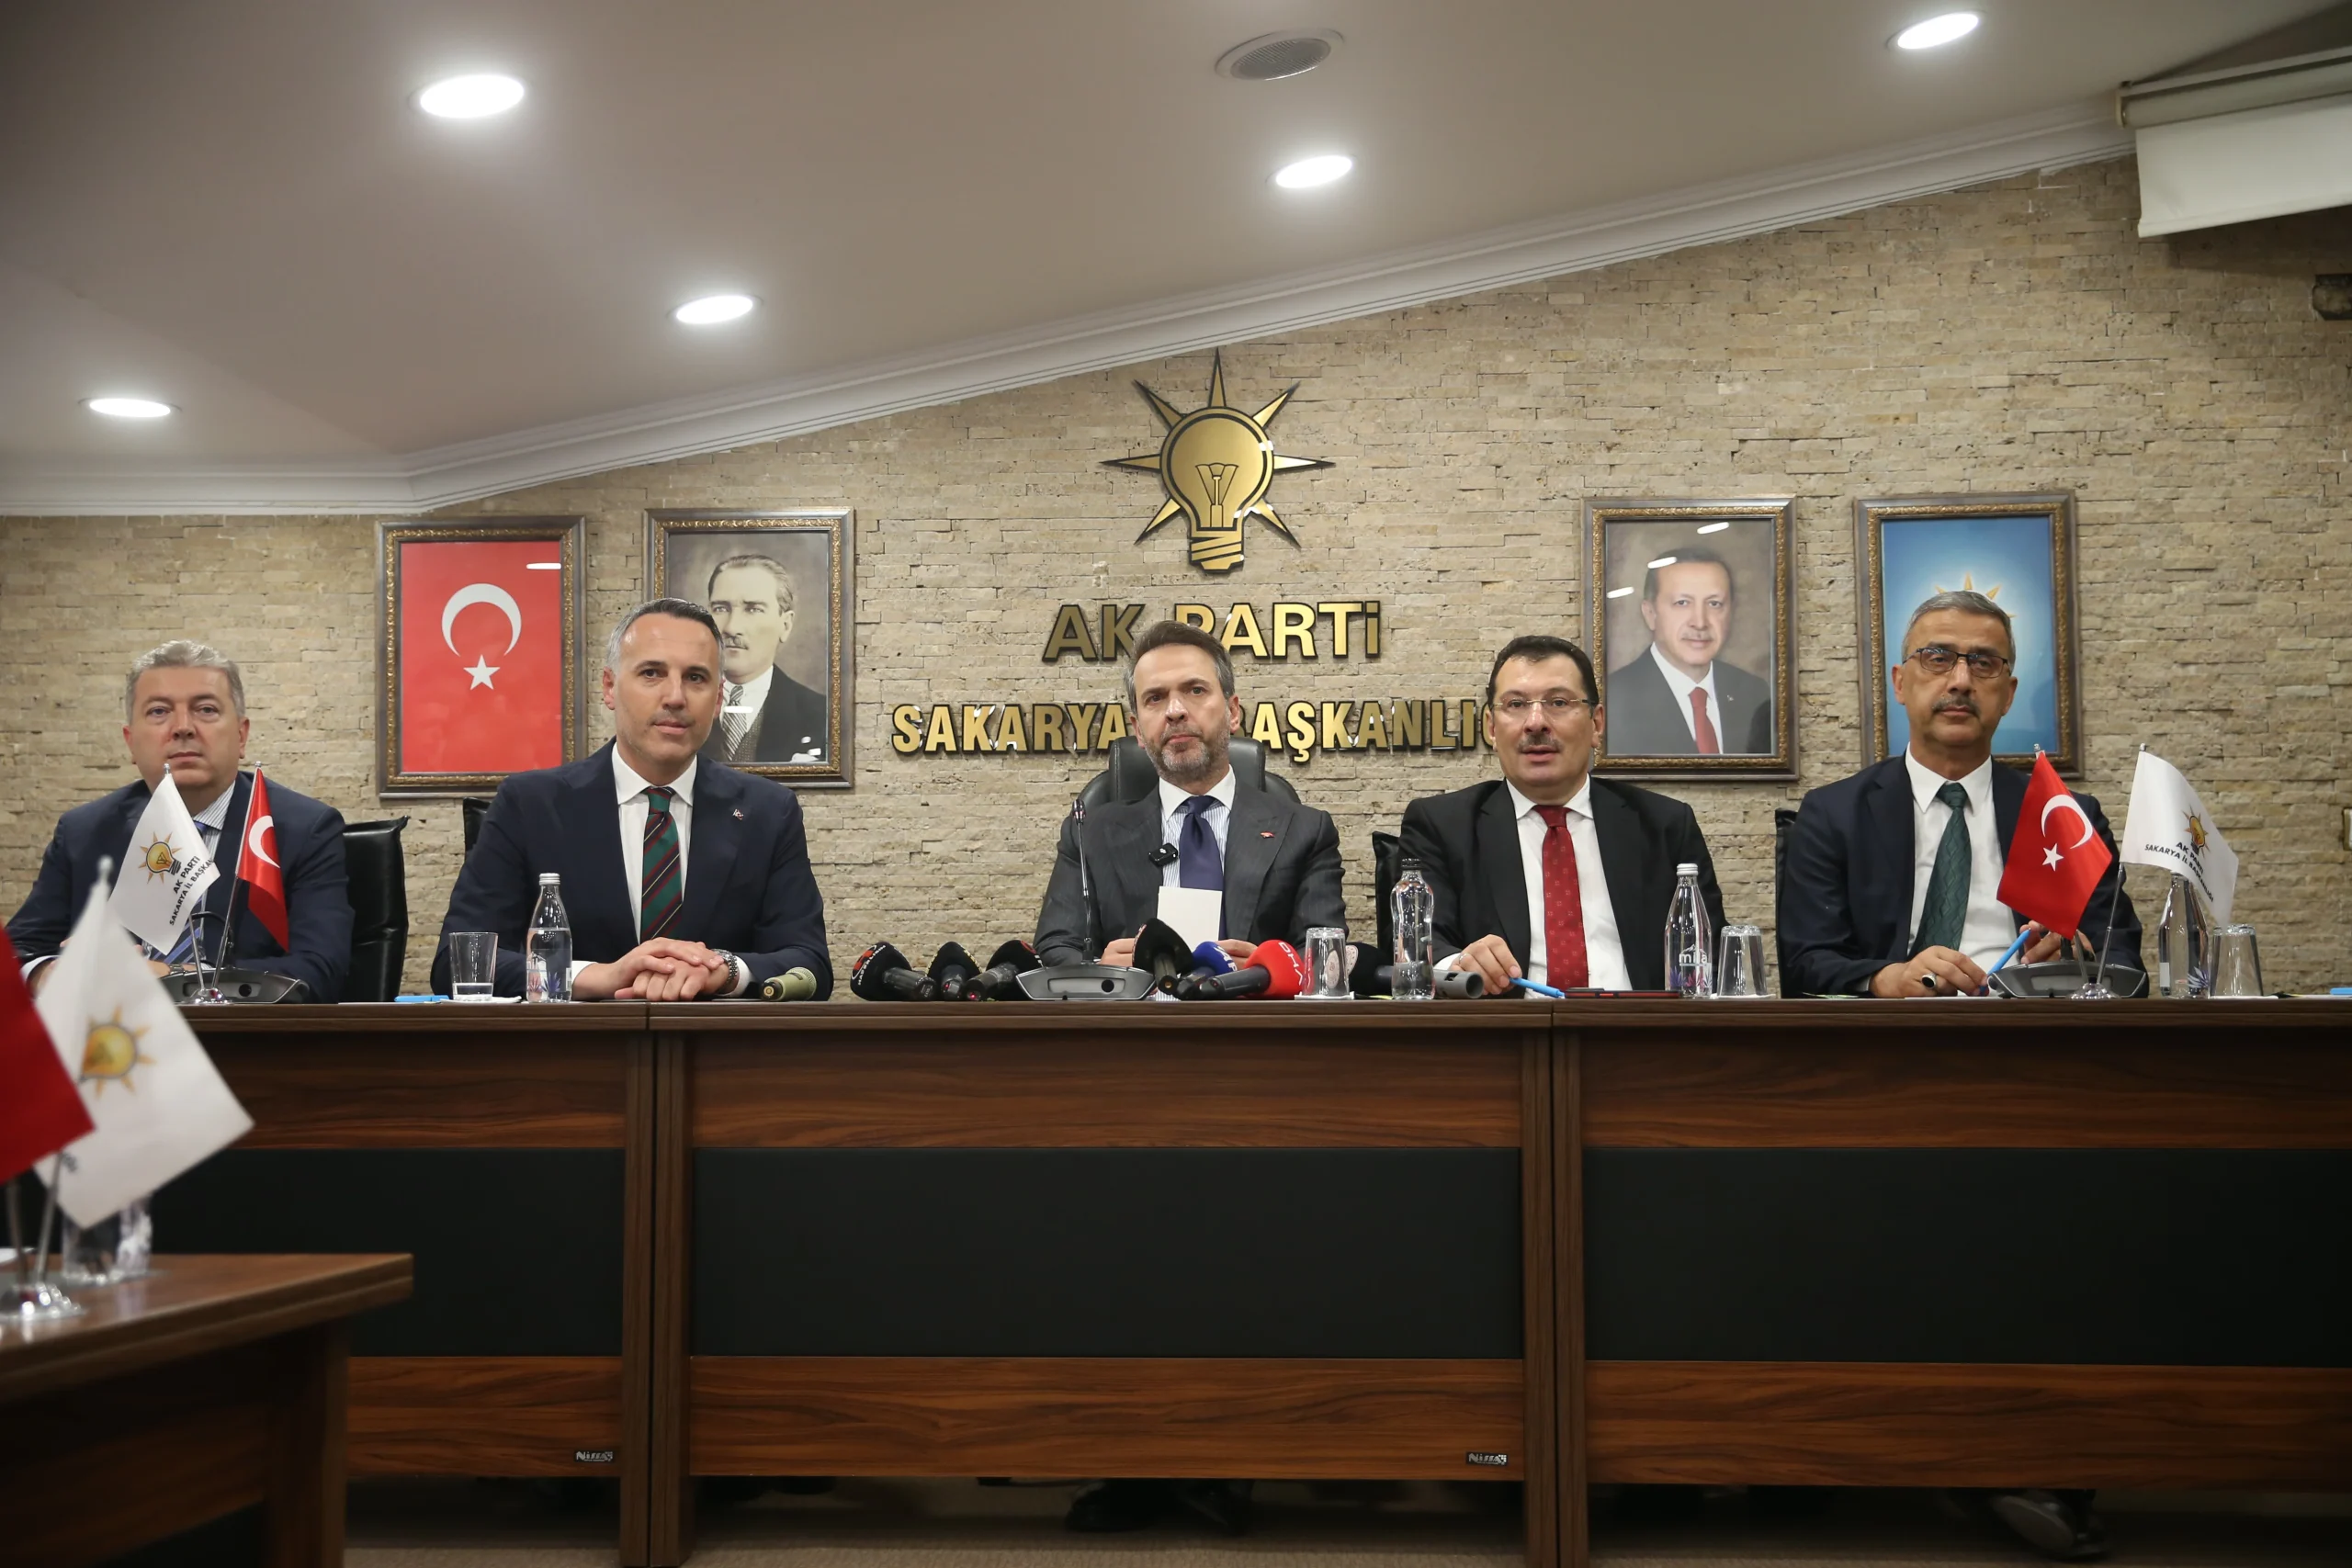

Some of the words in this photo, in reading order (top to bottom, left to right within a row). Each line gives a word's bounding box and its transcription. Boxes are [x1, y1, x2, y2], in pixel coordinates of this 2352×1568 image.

[1041, 603, 1146, 662] AK
[891, 703, 1128, 756] SAKARYA
[2144, 843, 2180, 860] SAKARYA
[2176, 841, 2189, 854] AK
[169, 890, 188, 926] SAKARYA
[184, 882, 194, 890] İL
[173, 879, 183, 894] AK
[1278, 942, 1303, 986] DHA
